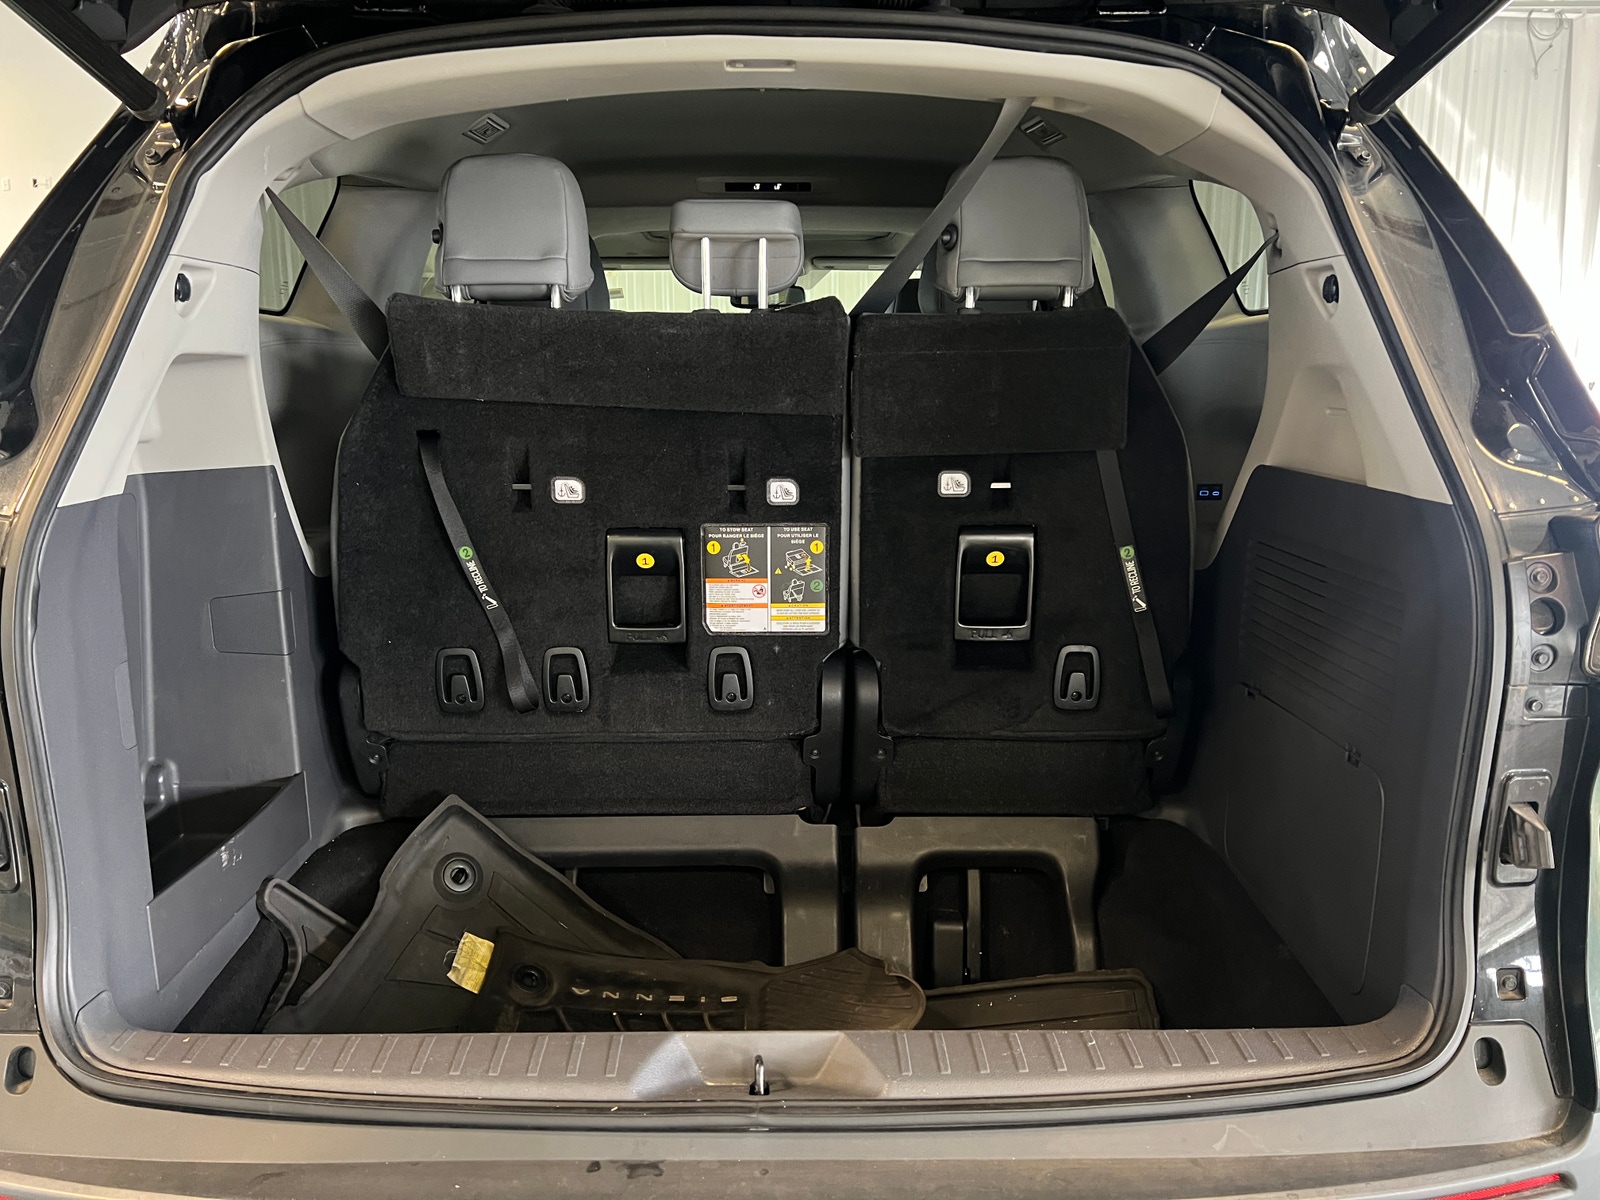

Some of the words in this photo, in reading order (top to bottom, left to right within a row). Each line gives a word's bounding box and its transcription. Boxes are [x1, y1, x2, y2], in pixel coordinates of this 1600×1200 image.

[478, 584, 488, 593] TO
[1132, 586, 1141, 594] TO
[971, 629, 998, 639] PULL
[572, 986, 738, 1003] SIENNA
